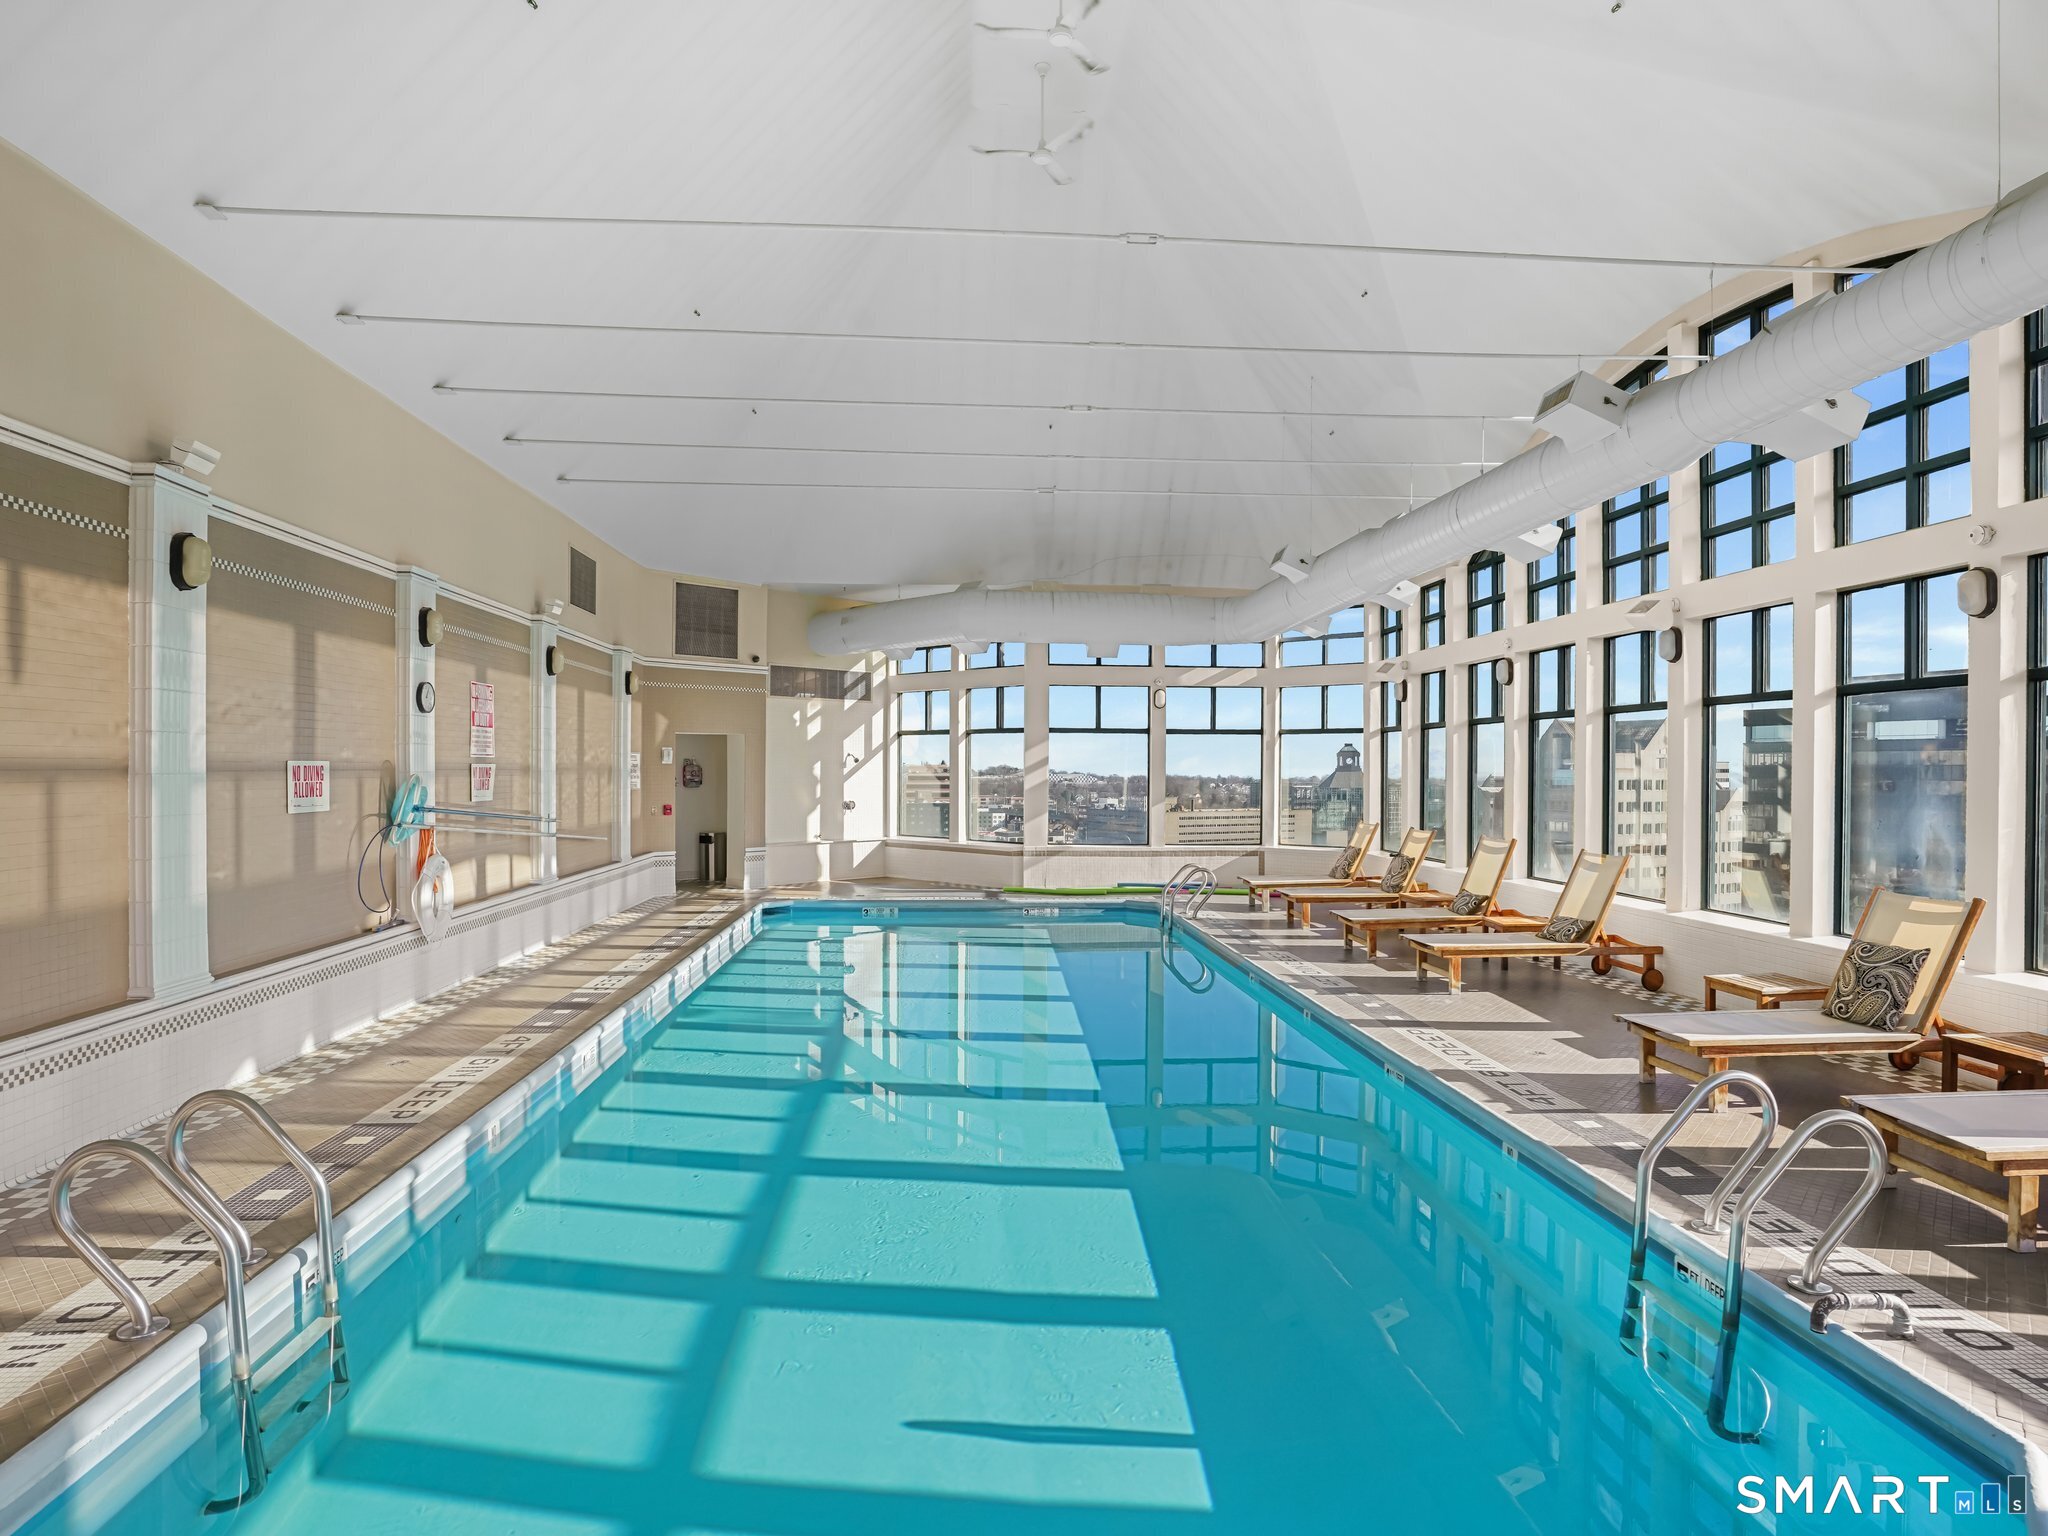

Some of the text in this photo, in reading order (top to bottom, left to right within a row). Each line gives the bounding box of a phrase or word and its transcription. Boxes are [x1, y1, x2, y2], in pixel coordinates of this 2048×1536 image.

[292, 765, 324, 781] NO DIVING
[294, 781, 323, 798] ALLOWED
[485, 1036, 532, 1056] 4FT
[1406, 1028, 1472, 1060] DEEP
[389, 1081, 467, 1120] DEEP
[1495, 1080, 1557, 1108] 4FT
[1689, 1270, 1699, 1283] FT
[1704, 1278, 1725, 1300] DEEP
